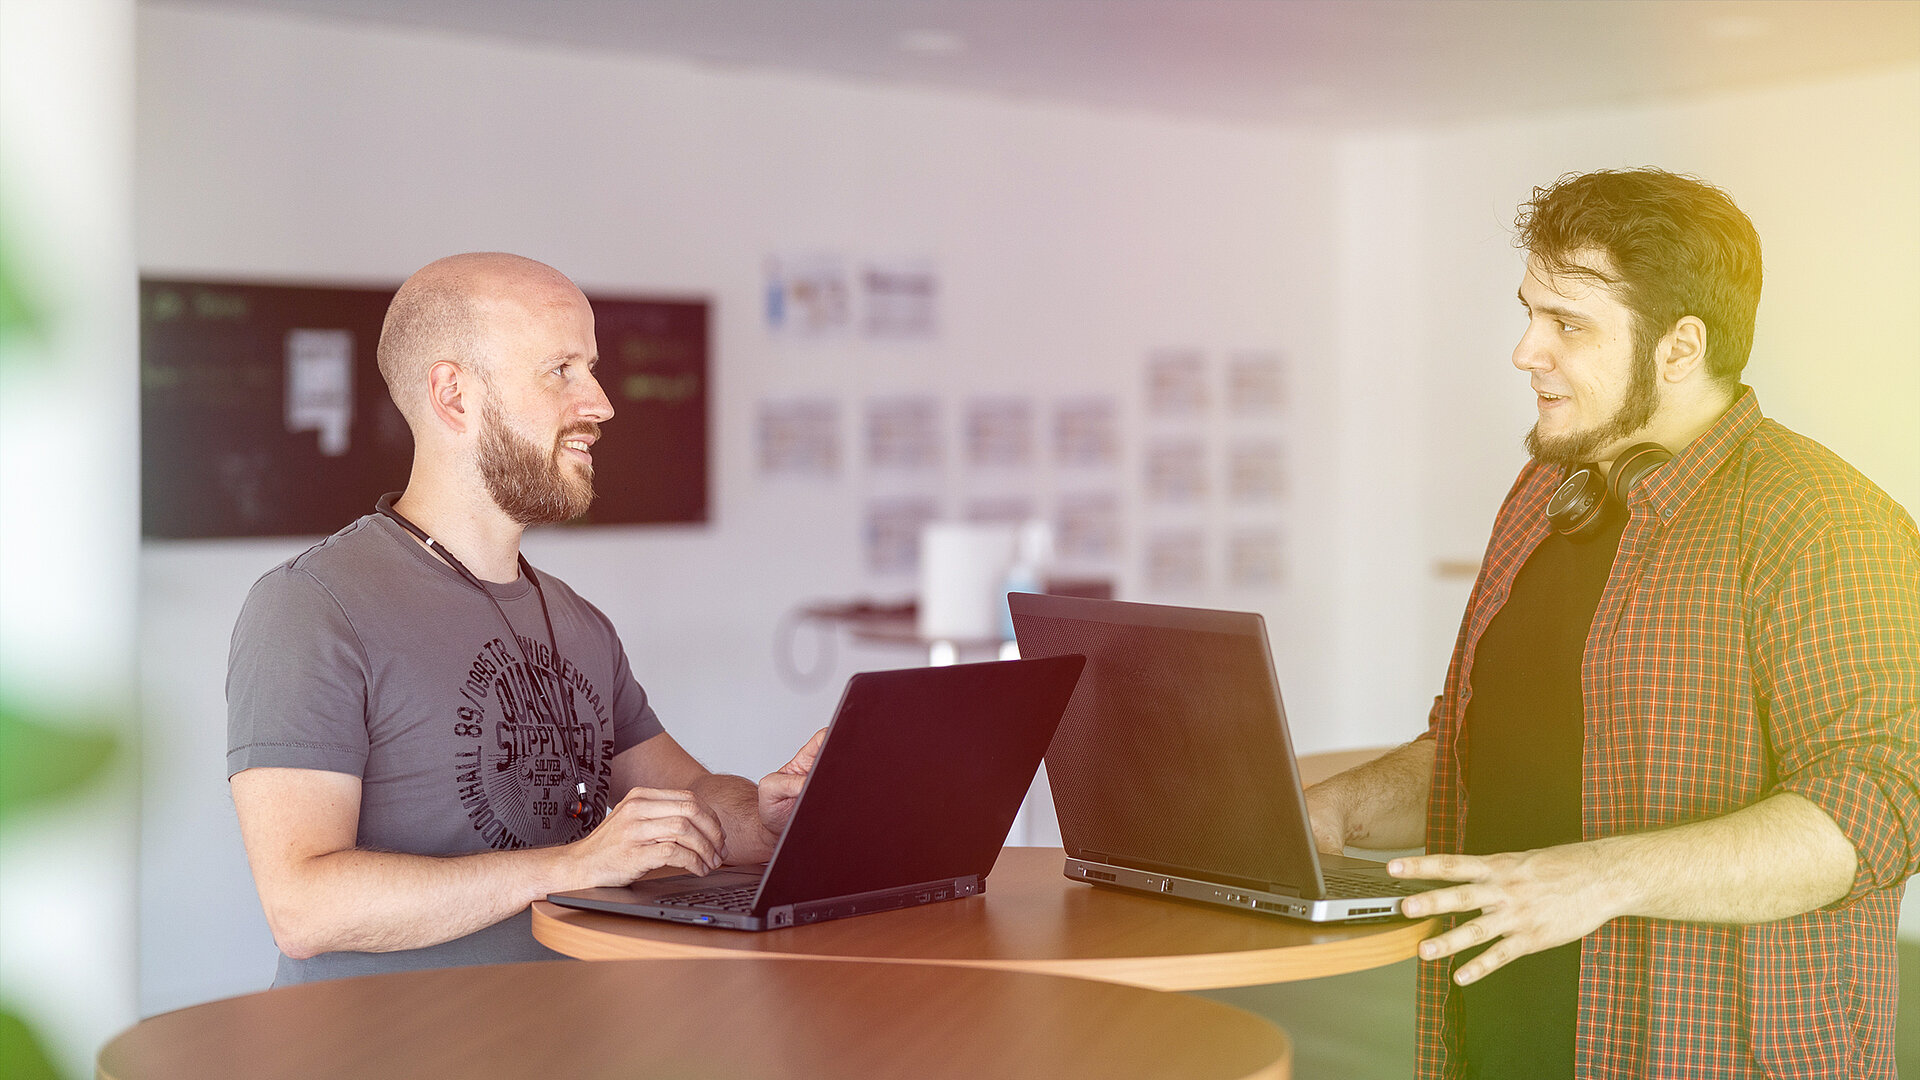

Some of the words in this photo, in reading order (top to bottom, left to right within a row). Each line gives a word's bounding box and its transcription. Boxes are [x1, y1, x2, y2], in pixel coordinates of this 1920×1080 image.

[495, 720, 596, 773] SUPPLIER
[455, 746, 533, 849] ANDOMHALL
[532, 801, 558, 816] 97228
